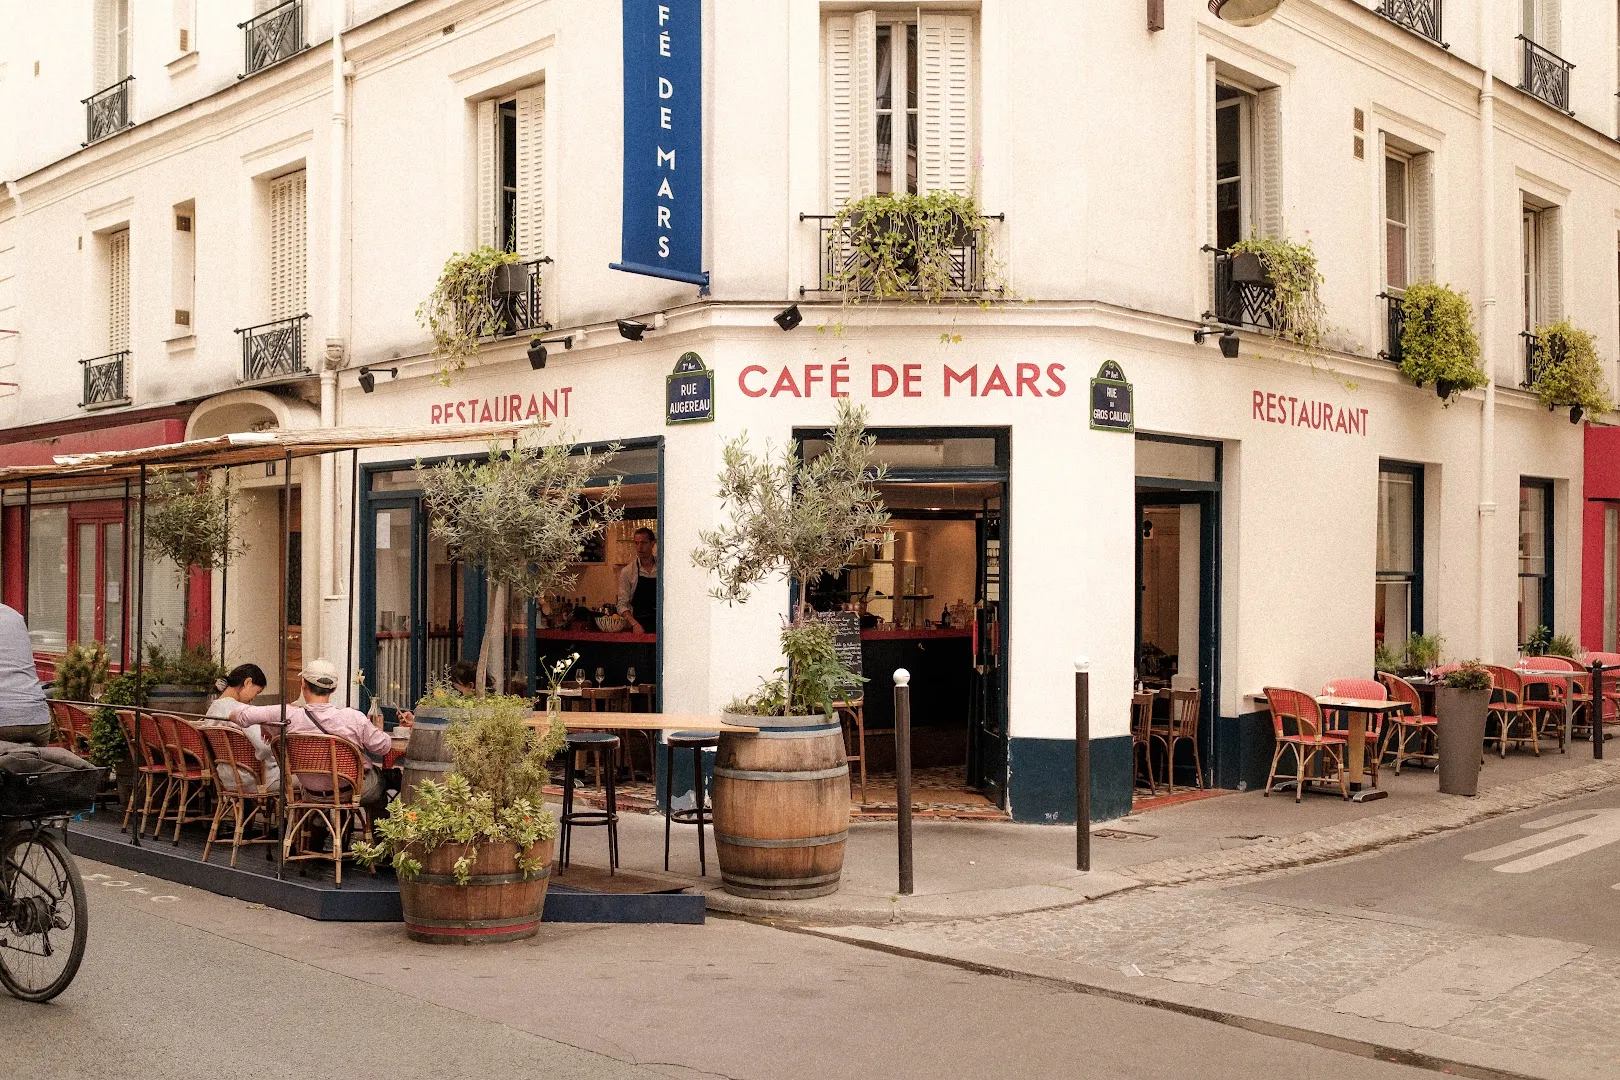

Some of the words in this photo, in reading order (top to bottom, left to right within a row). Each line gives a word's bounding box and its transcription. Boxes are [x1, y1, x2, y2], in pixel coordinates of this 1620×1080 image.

[658, 76, 673, 130] DE
[656, 144, 676, 258] MARS
[681, 383, 697, 396] RUE
[738, 357, 850, 398] CAFÉ
[871, 363, 922, 398] DE
[943, 362, 1067, 398] MARS
[1107, 387, 1117, 399] RUE
[431, 386, 573, 425] RESTAURANT
[670, 399, 709, 415] AUGEREAU
[1093, 409, 1108, 420] GROS
[1109, 411, 1130, 423] CAILLOU
[1252, 390, 1369, 437] RESTAURANT
